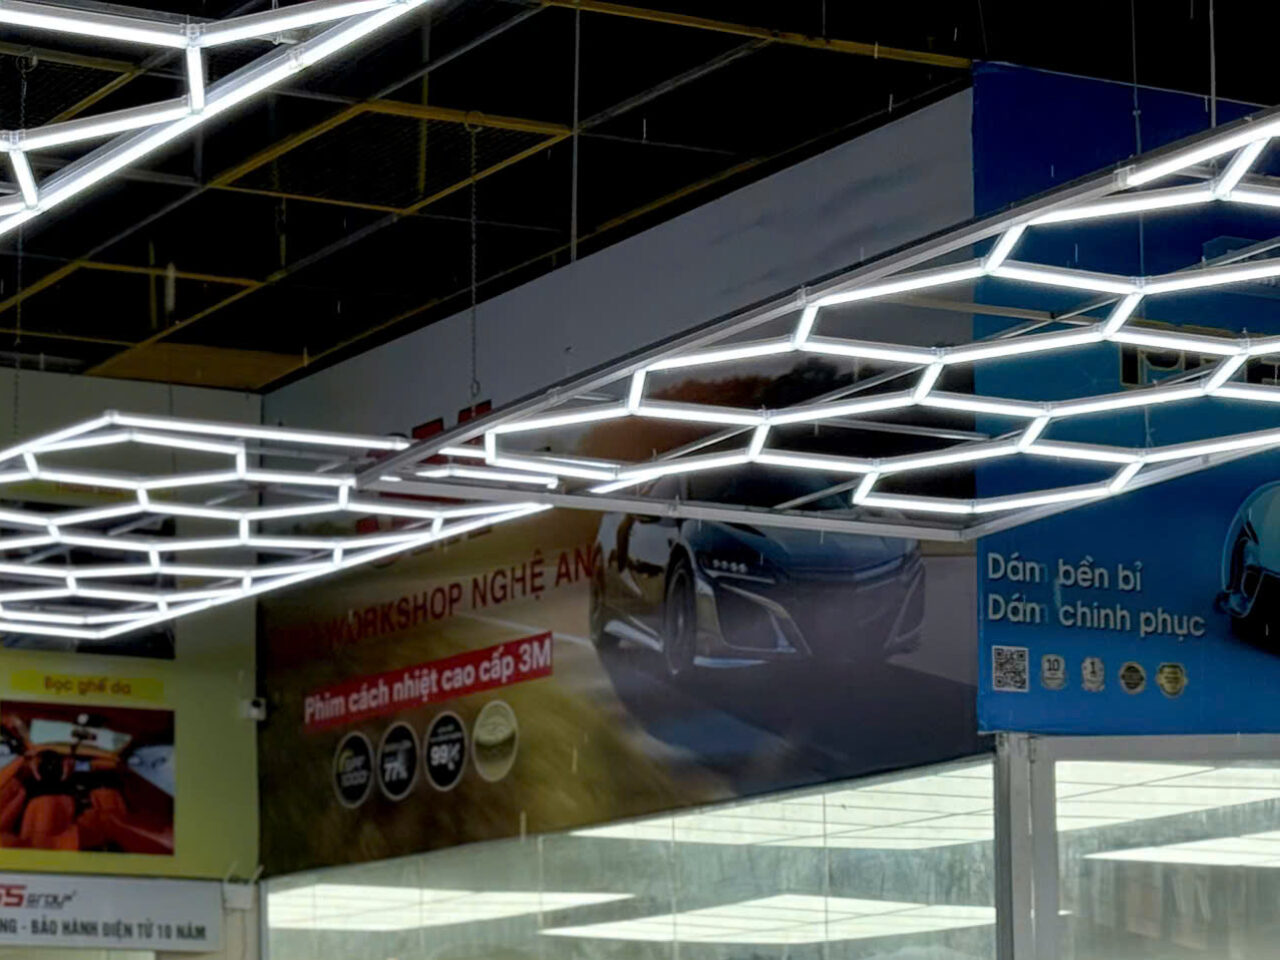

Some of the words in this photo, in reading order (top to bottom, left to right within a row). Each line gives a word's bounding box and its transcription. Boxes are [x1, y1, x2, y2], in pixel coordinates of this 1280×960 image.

[1058, 555, 1109, 589] bền
[1118, 561, 1143, 591] bỉ
[1139, 607, 1206, 641] phục
[304, 688, 346, 724] Phim
[348, 678, 390, 714] cách
[393, 669, 439, 702] nhiệt
[441, 665, 475, 691] cao
[479, 645, 515, 683] cấp
[517, 636, 553, 673] 3M
